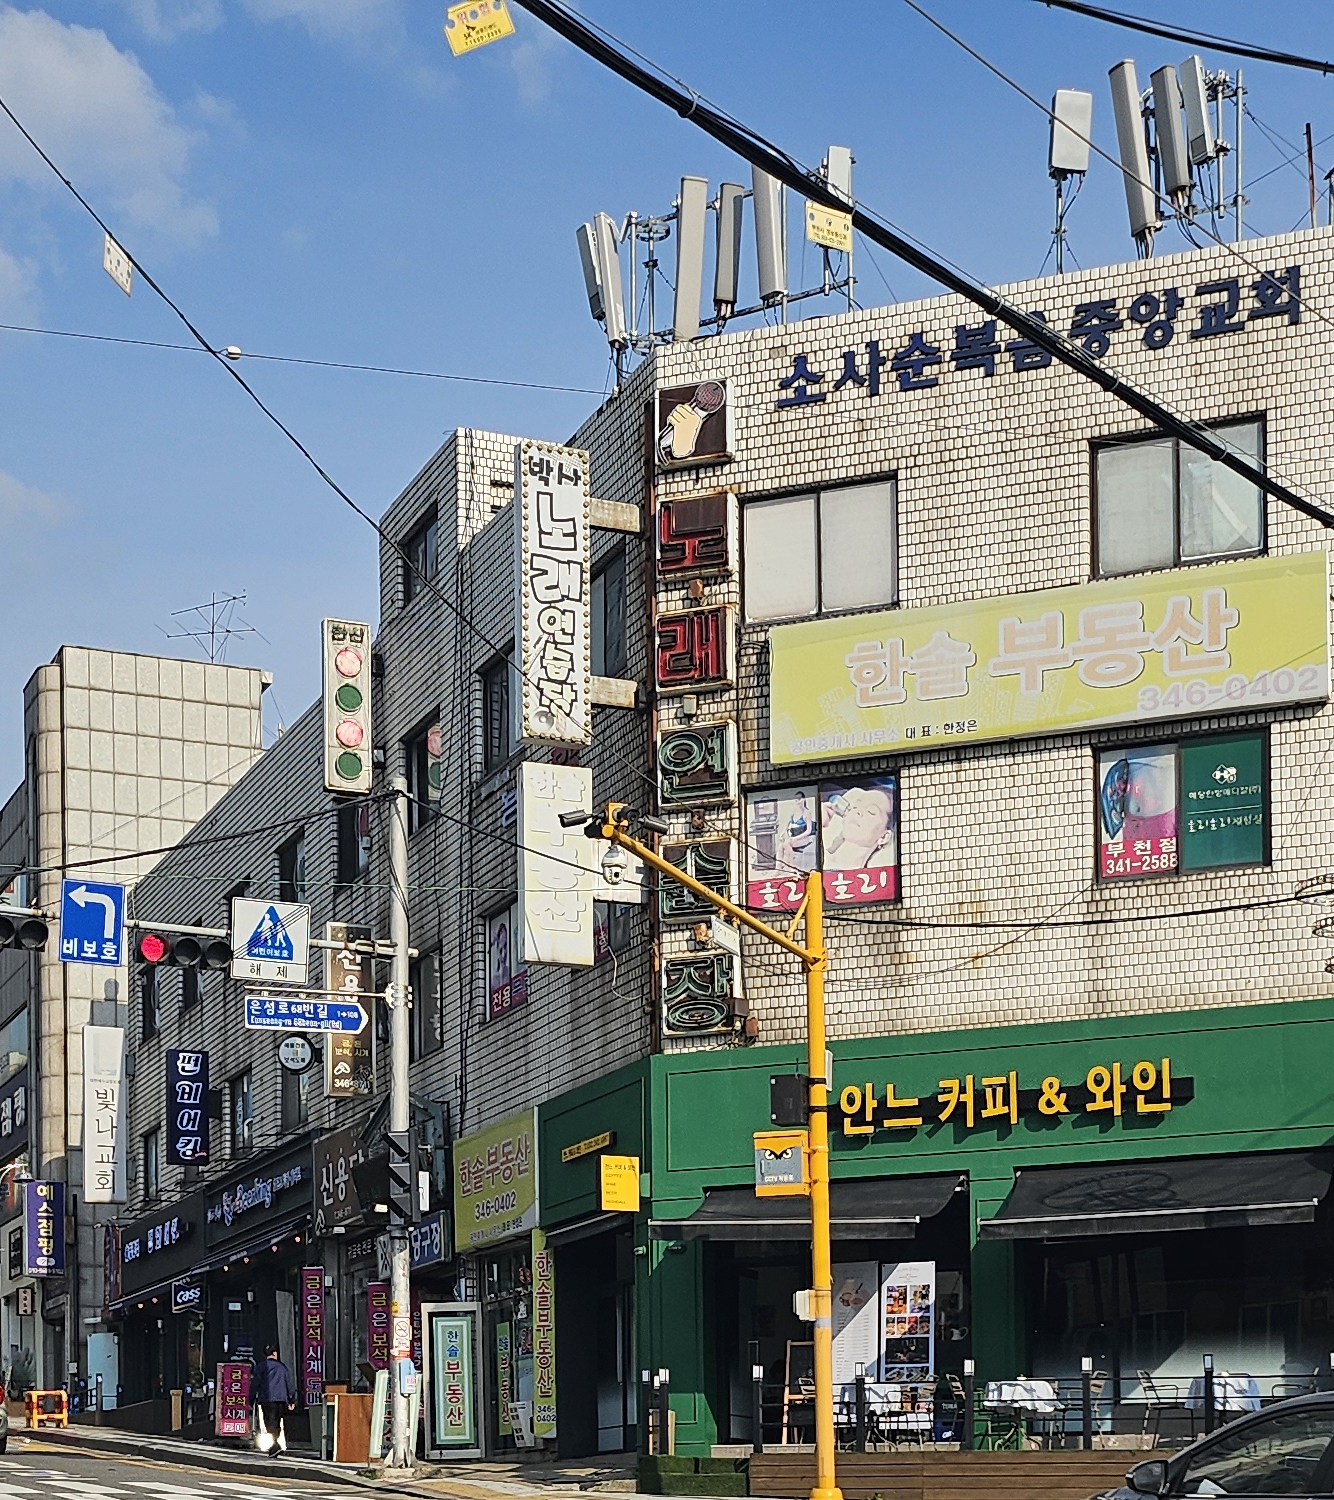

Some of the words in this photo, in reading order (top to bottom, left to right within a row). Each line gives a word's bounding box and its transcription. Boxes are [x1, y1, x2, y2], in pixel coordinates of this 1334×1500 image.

[846, 632, 975, 707] 한솔
[989, 587, 1238, 695] 부동산
[1138, 667, 1320, 713] 346-0402
[1105, 852, 1178, 876] 341-2588
[62, 939, 119, 963] 비보호
[839, 1080, 922, 1136] 안느
[937, 1070, 1019, 1129] 커피
[1038, 1075, 1069, 1115] &
[1085, 1057, 1174, 1116] 와인
[94, 1087, 119, 1196] 빛나교회
[485, 1137, 531, 1190] 부동산
[474, 1189, 517, 1222] 346-0402
[371, 1291, 387, 1308] 금
[306, 1313, 323, 1342] 보석
[534, 1252, 553, 1398] 한솔부동산
[306, 1345, 323, 1374] 시계
[371, 1333, 388, 1363] 보석
[225, 1394, 247, 1407] 보석
[444, 1359, 464, 1428] 부동산
[224, 1408, 247, 1421] 시계
